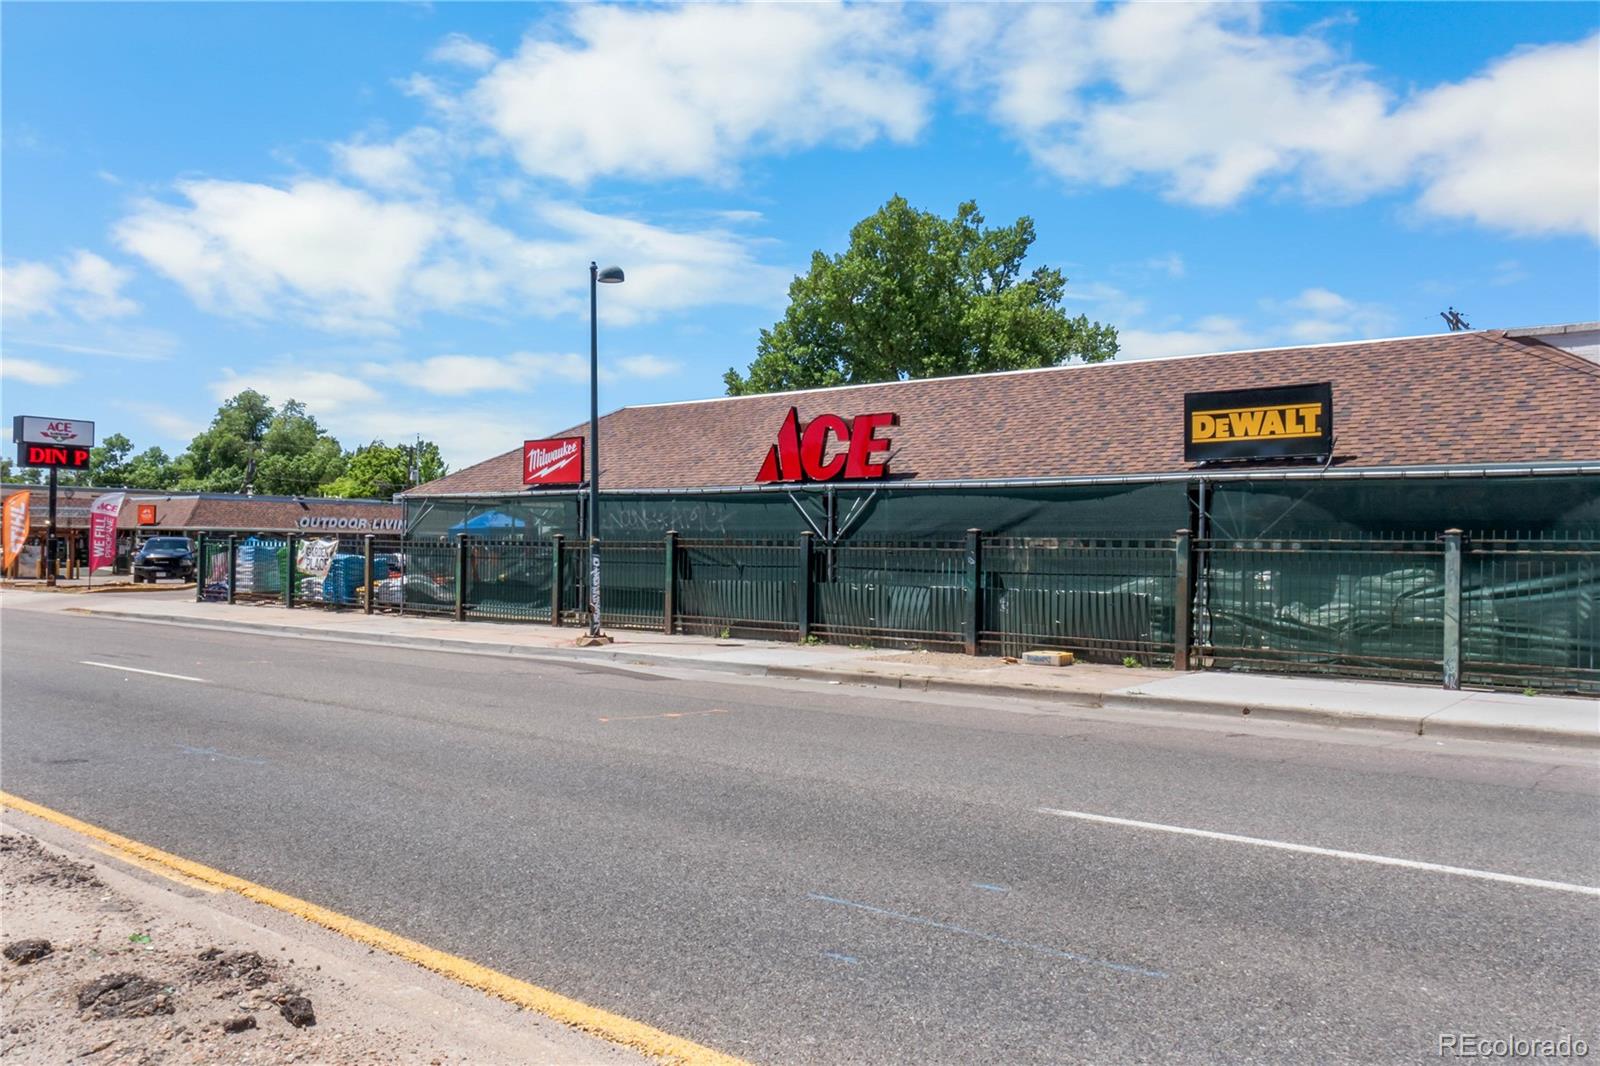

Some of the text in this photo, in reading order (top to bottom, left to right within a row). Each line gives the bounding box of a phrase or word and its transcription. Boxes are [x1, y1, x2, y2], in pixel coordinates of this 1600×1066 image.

[47, 422, 72, 432] ACE
[29, 447, 89, 466] DIN P
[526, 441, 578, 472] Milwaukee
[755, 406, 897, 482] ACE
[97, 502, 118, 512] ACE
[300, 517, 368, 529] OUTDOOR
[93, 518, 105, 557] WE FILL
[104, 516, 114, 558] PROPANE
